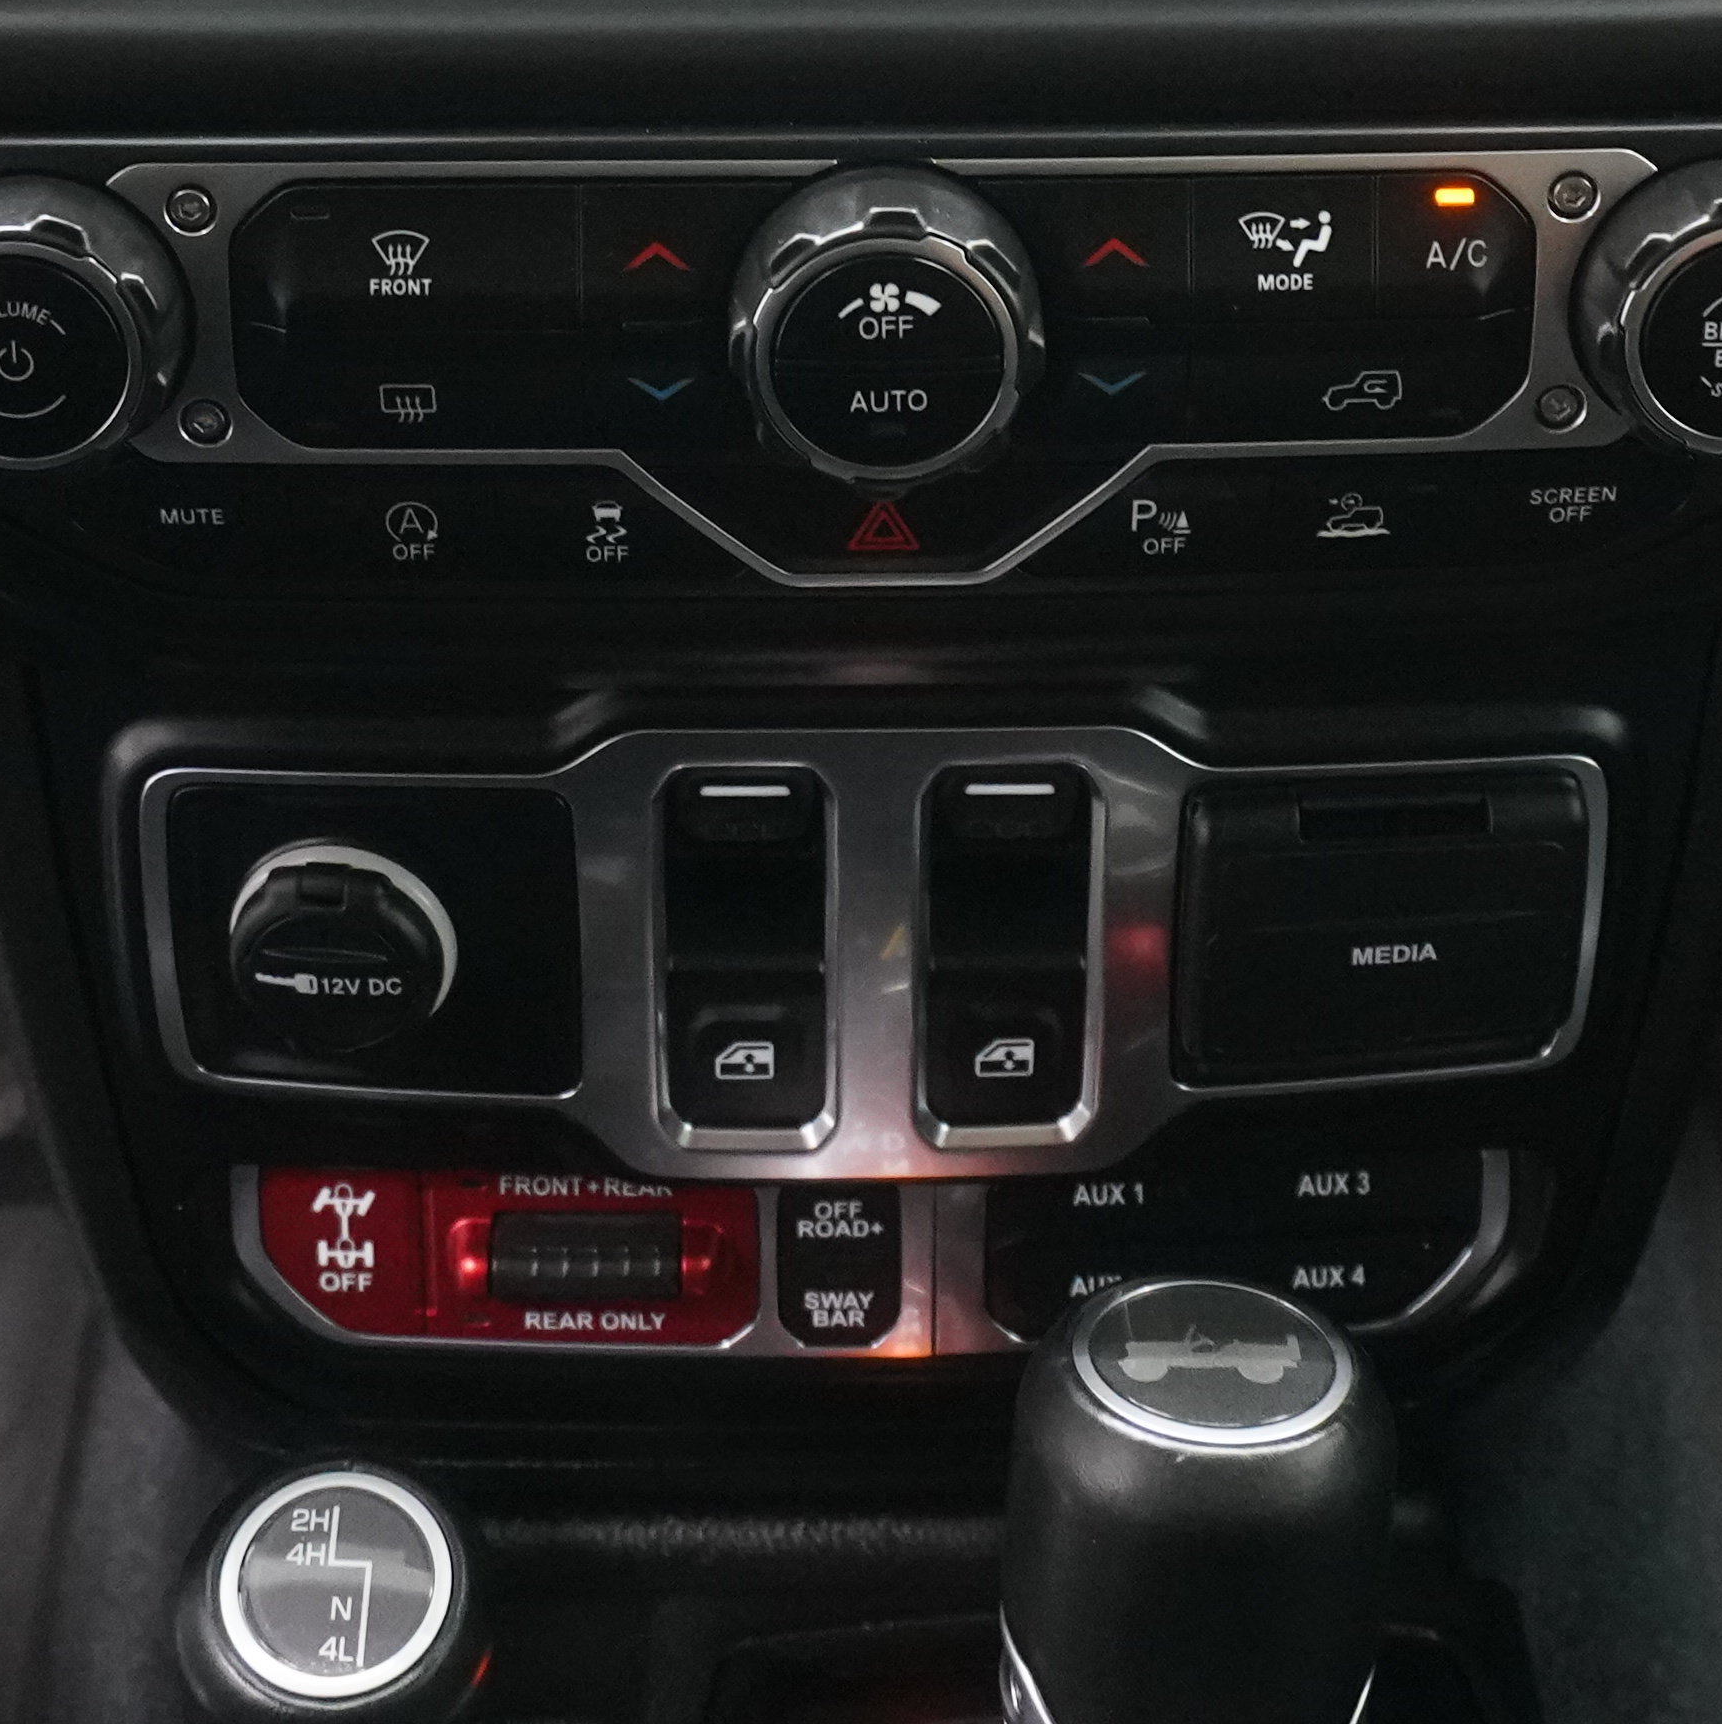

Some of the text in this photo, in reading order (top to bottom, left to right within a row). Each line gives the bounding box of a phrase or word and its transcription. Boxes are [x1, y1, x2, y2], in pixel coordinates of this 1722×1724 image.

[1426, 239, 1489, 271] A/C
[368, 278, 432, 298] FRONT
[1258, 273, 1313, 292] MODE
[858, 315, 914, 341] OFF
[850, 390, 928, 413] AUTO
[1530, 486, 1616, 506] SCREEN
[160, 507, 225, 525] MUTE
[1548, 504, 1592, 524] OFF
[392, 542, 435, 561] OFF
[585, 544, 629, 562] OFF
[1142, 538, 1185, 555] OFF
[1351, 942, 1437, 967] MEDIA
[321, 975, 402, 997] 12V DC
[1073, 1182, 1146, 1206] AUX 1
[1298, 1171, 1372, 1197] AUX 3
[815, 1201, 862, 1220] OFF
[797, 1218, 885, 1240] ROAD+
[319, 1272, 372, 1294] OFF
[1295, 1265, 1366, 1290] AUX 4
[805, 1291, 875, 1312] SWAY
[525, 1311, 666, 1330] REAR ONLY
[812, 1308, 866, 1328] BAR
[291, 1508, 329, 1532] 2H
[286, 1543, 326, 1567] 4H
[330, 1596, 353, 1621] N
[318, 1637, 355, 1662] 4L
